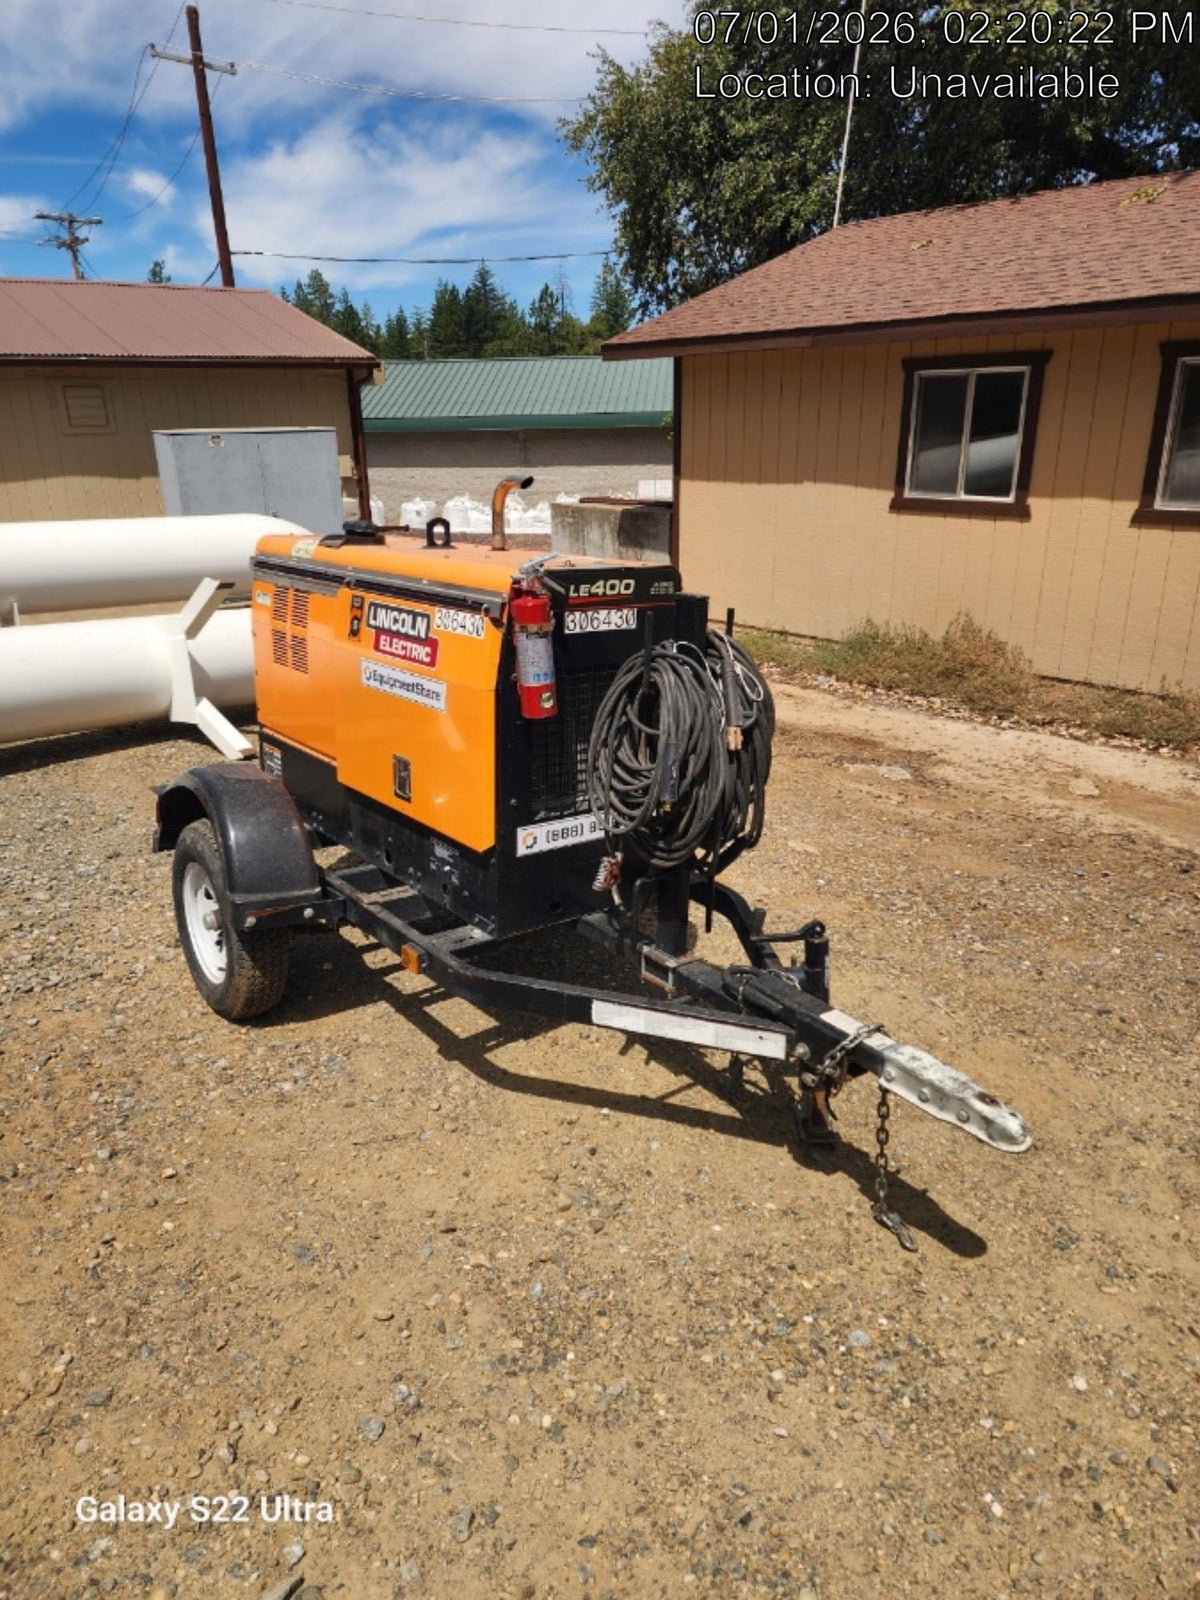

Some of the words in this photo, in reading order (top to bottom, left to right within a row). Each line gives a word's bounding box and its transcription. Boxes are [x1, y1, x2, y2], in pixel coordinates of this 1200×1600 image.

[569, 579, 635, 597] LE400
[369, 606, 428, 639] LINCOLN
[566, 611, 636, 633] 306430
[379, 635, 432, 663] ELECTRIC
[372, 669, 441, 702] EquipmentShare
